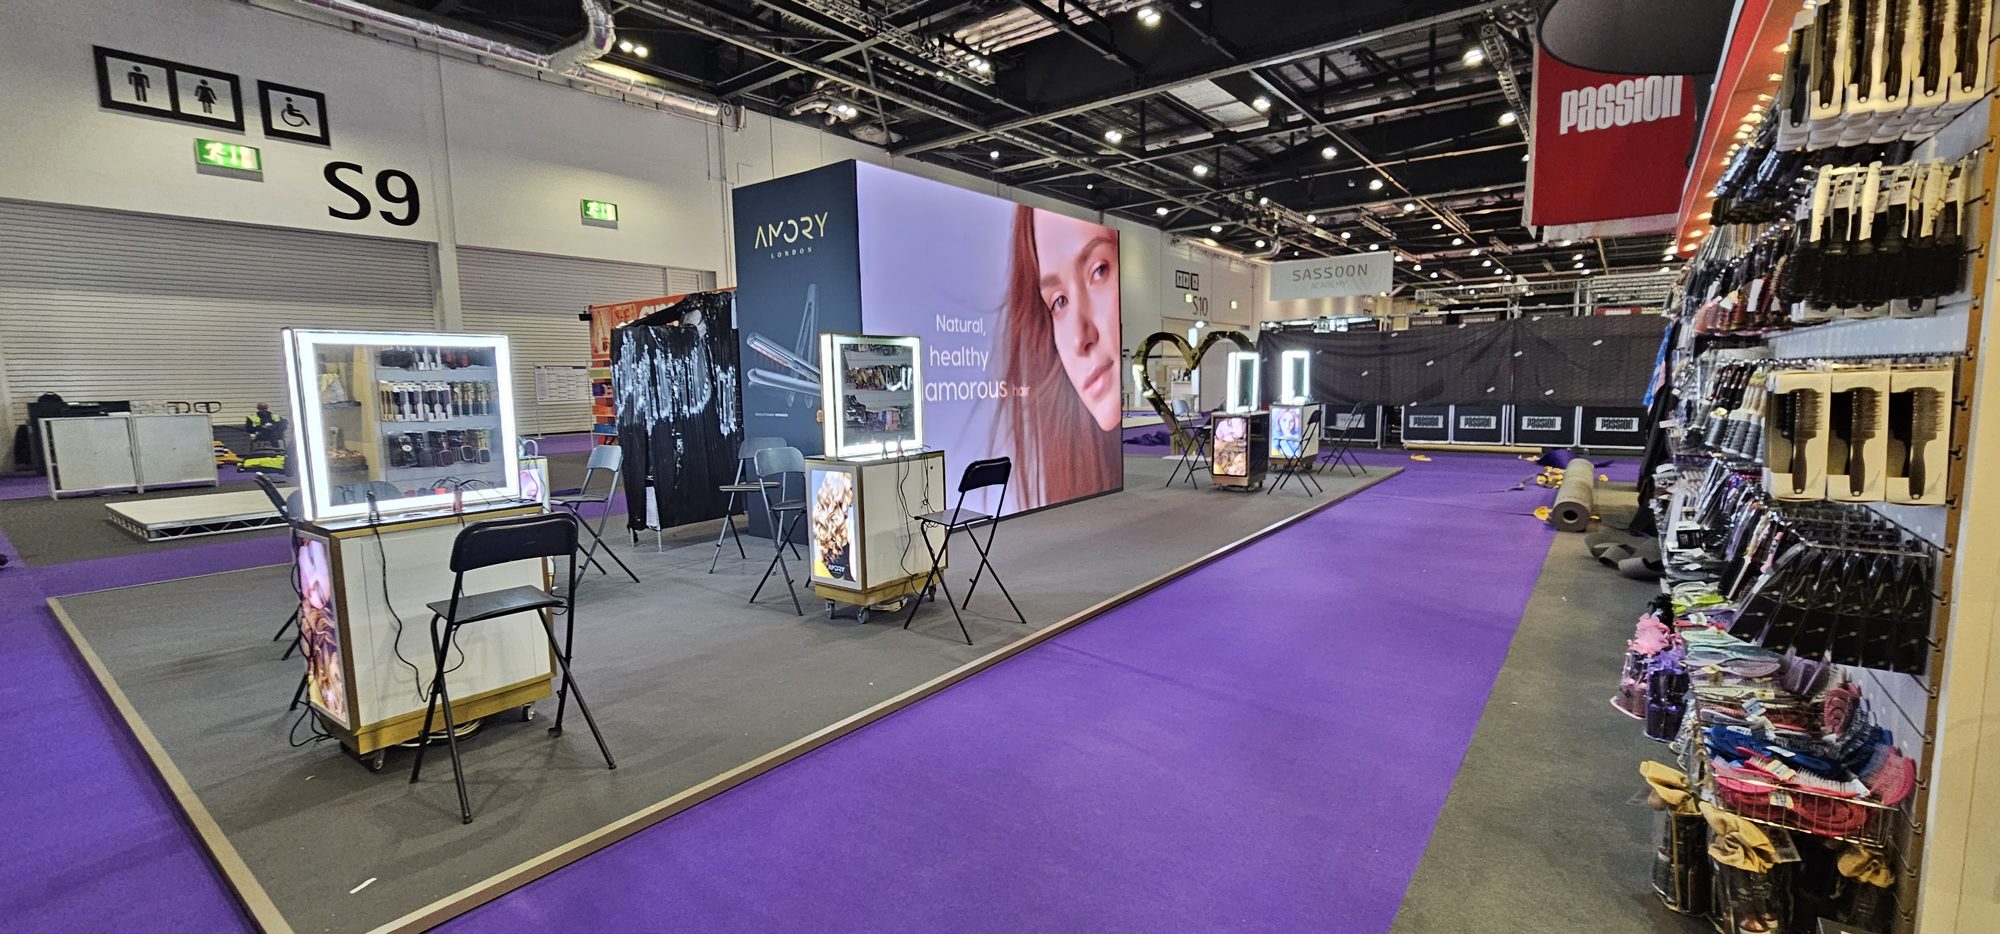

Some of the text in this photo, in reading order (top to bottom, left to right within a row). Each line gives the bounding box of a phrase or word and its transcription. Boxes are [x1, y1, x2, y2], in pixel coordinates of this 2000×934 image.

[323, 161, 420, 226] S9
[754, 211, 828, 249] AMORY
[770, 247, 812, 259] LONDON
[1292, 264, 1368, 282] SASSOON
[1192, 296, 1209, 317] S10
[935, 314, 987, 336] Natural,
[929, 345, 989, 371] healthy
[922, 377, 1030, 401] amorous hair
